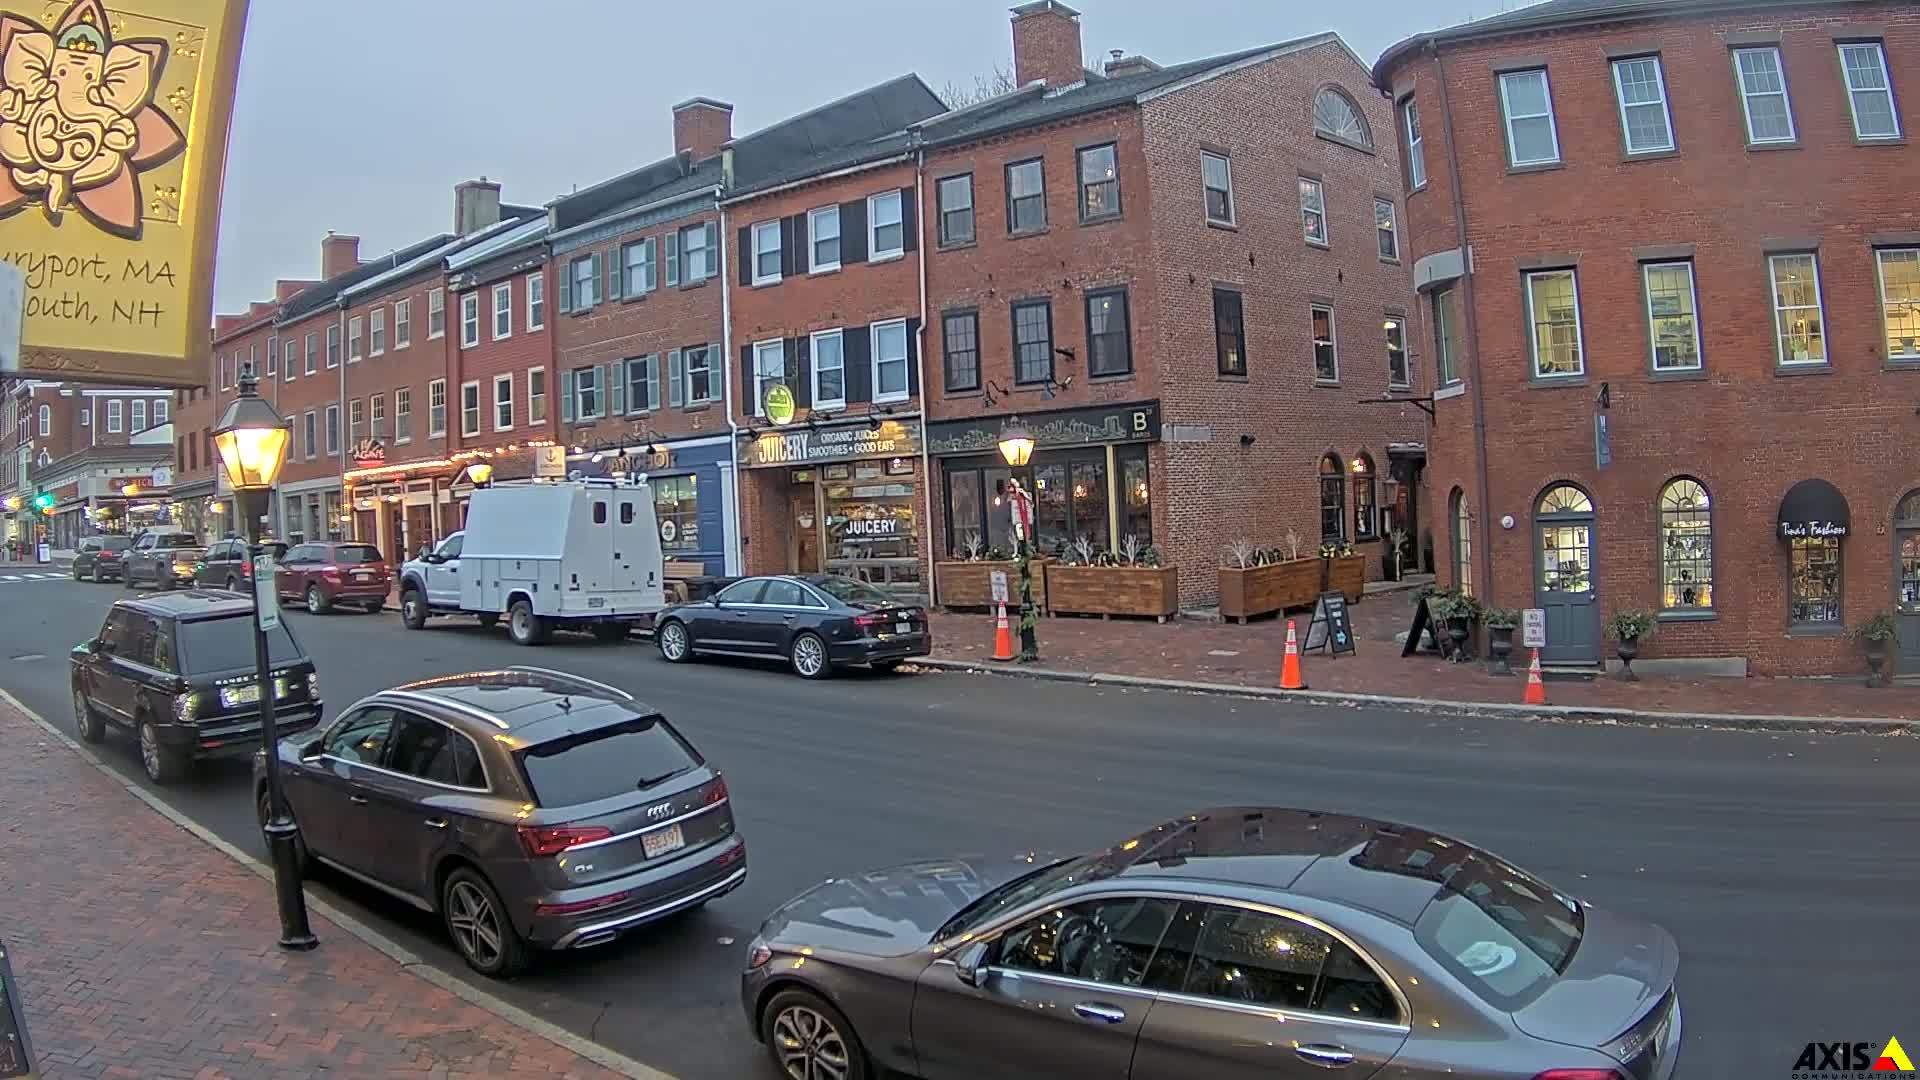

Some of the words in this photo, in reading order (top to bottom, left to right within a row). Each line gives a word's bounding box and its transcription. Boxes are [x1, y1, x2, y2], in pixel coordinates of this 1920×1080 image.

[123, 259, 176, 287] MA
[112, 300, 164, 327] NH
[1133, 412, 1147, 431] B
[820, 430, 853, 444] ORGANIC
[854, 429, 880, 441] JUICES
[759, 434, 809, 463] JUICERY
[808, 443, 848, 458] SMOOTHIES
[854, 440, 876, 454] GOOD
[877, 440, 895, 451] EATS
[846, 519, 897, 534] JUICERY
[1782, 522, 1806, 535] Tina's
[215, 676, 249, 685] RANGE
